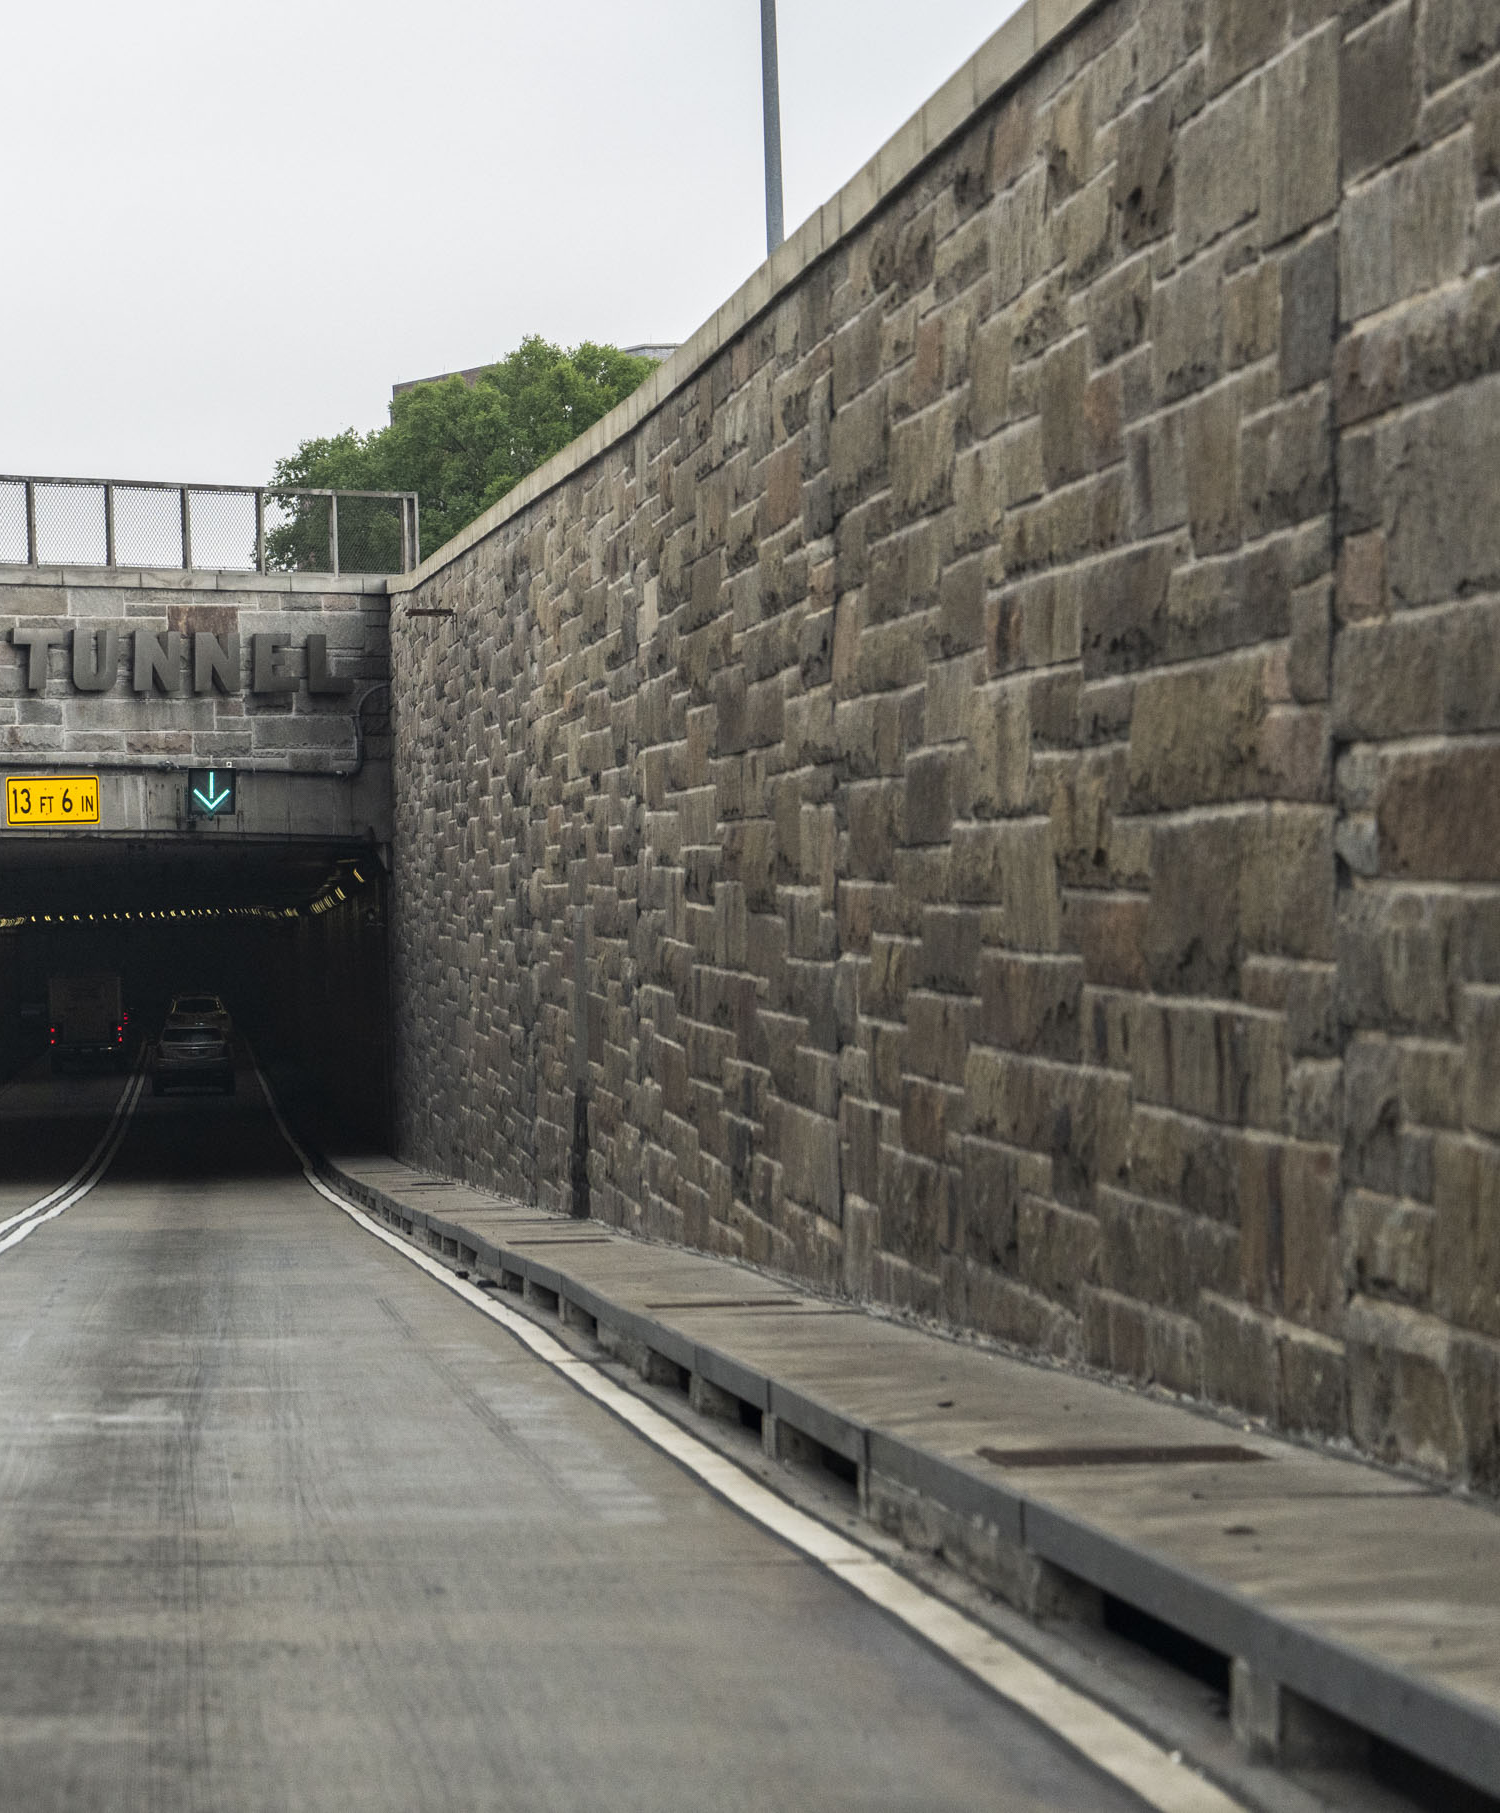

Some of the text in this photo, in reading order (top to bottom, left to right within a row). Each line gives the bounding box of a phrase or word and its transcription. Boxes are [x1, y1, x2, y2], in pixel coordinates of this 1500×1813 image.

[11, 627, 353, 694] TUNNEL
[12, 788, 94, 814] 13 FT 6 IN
